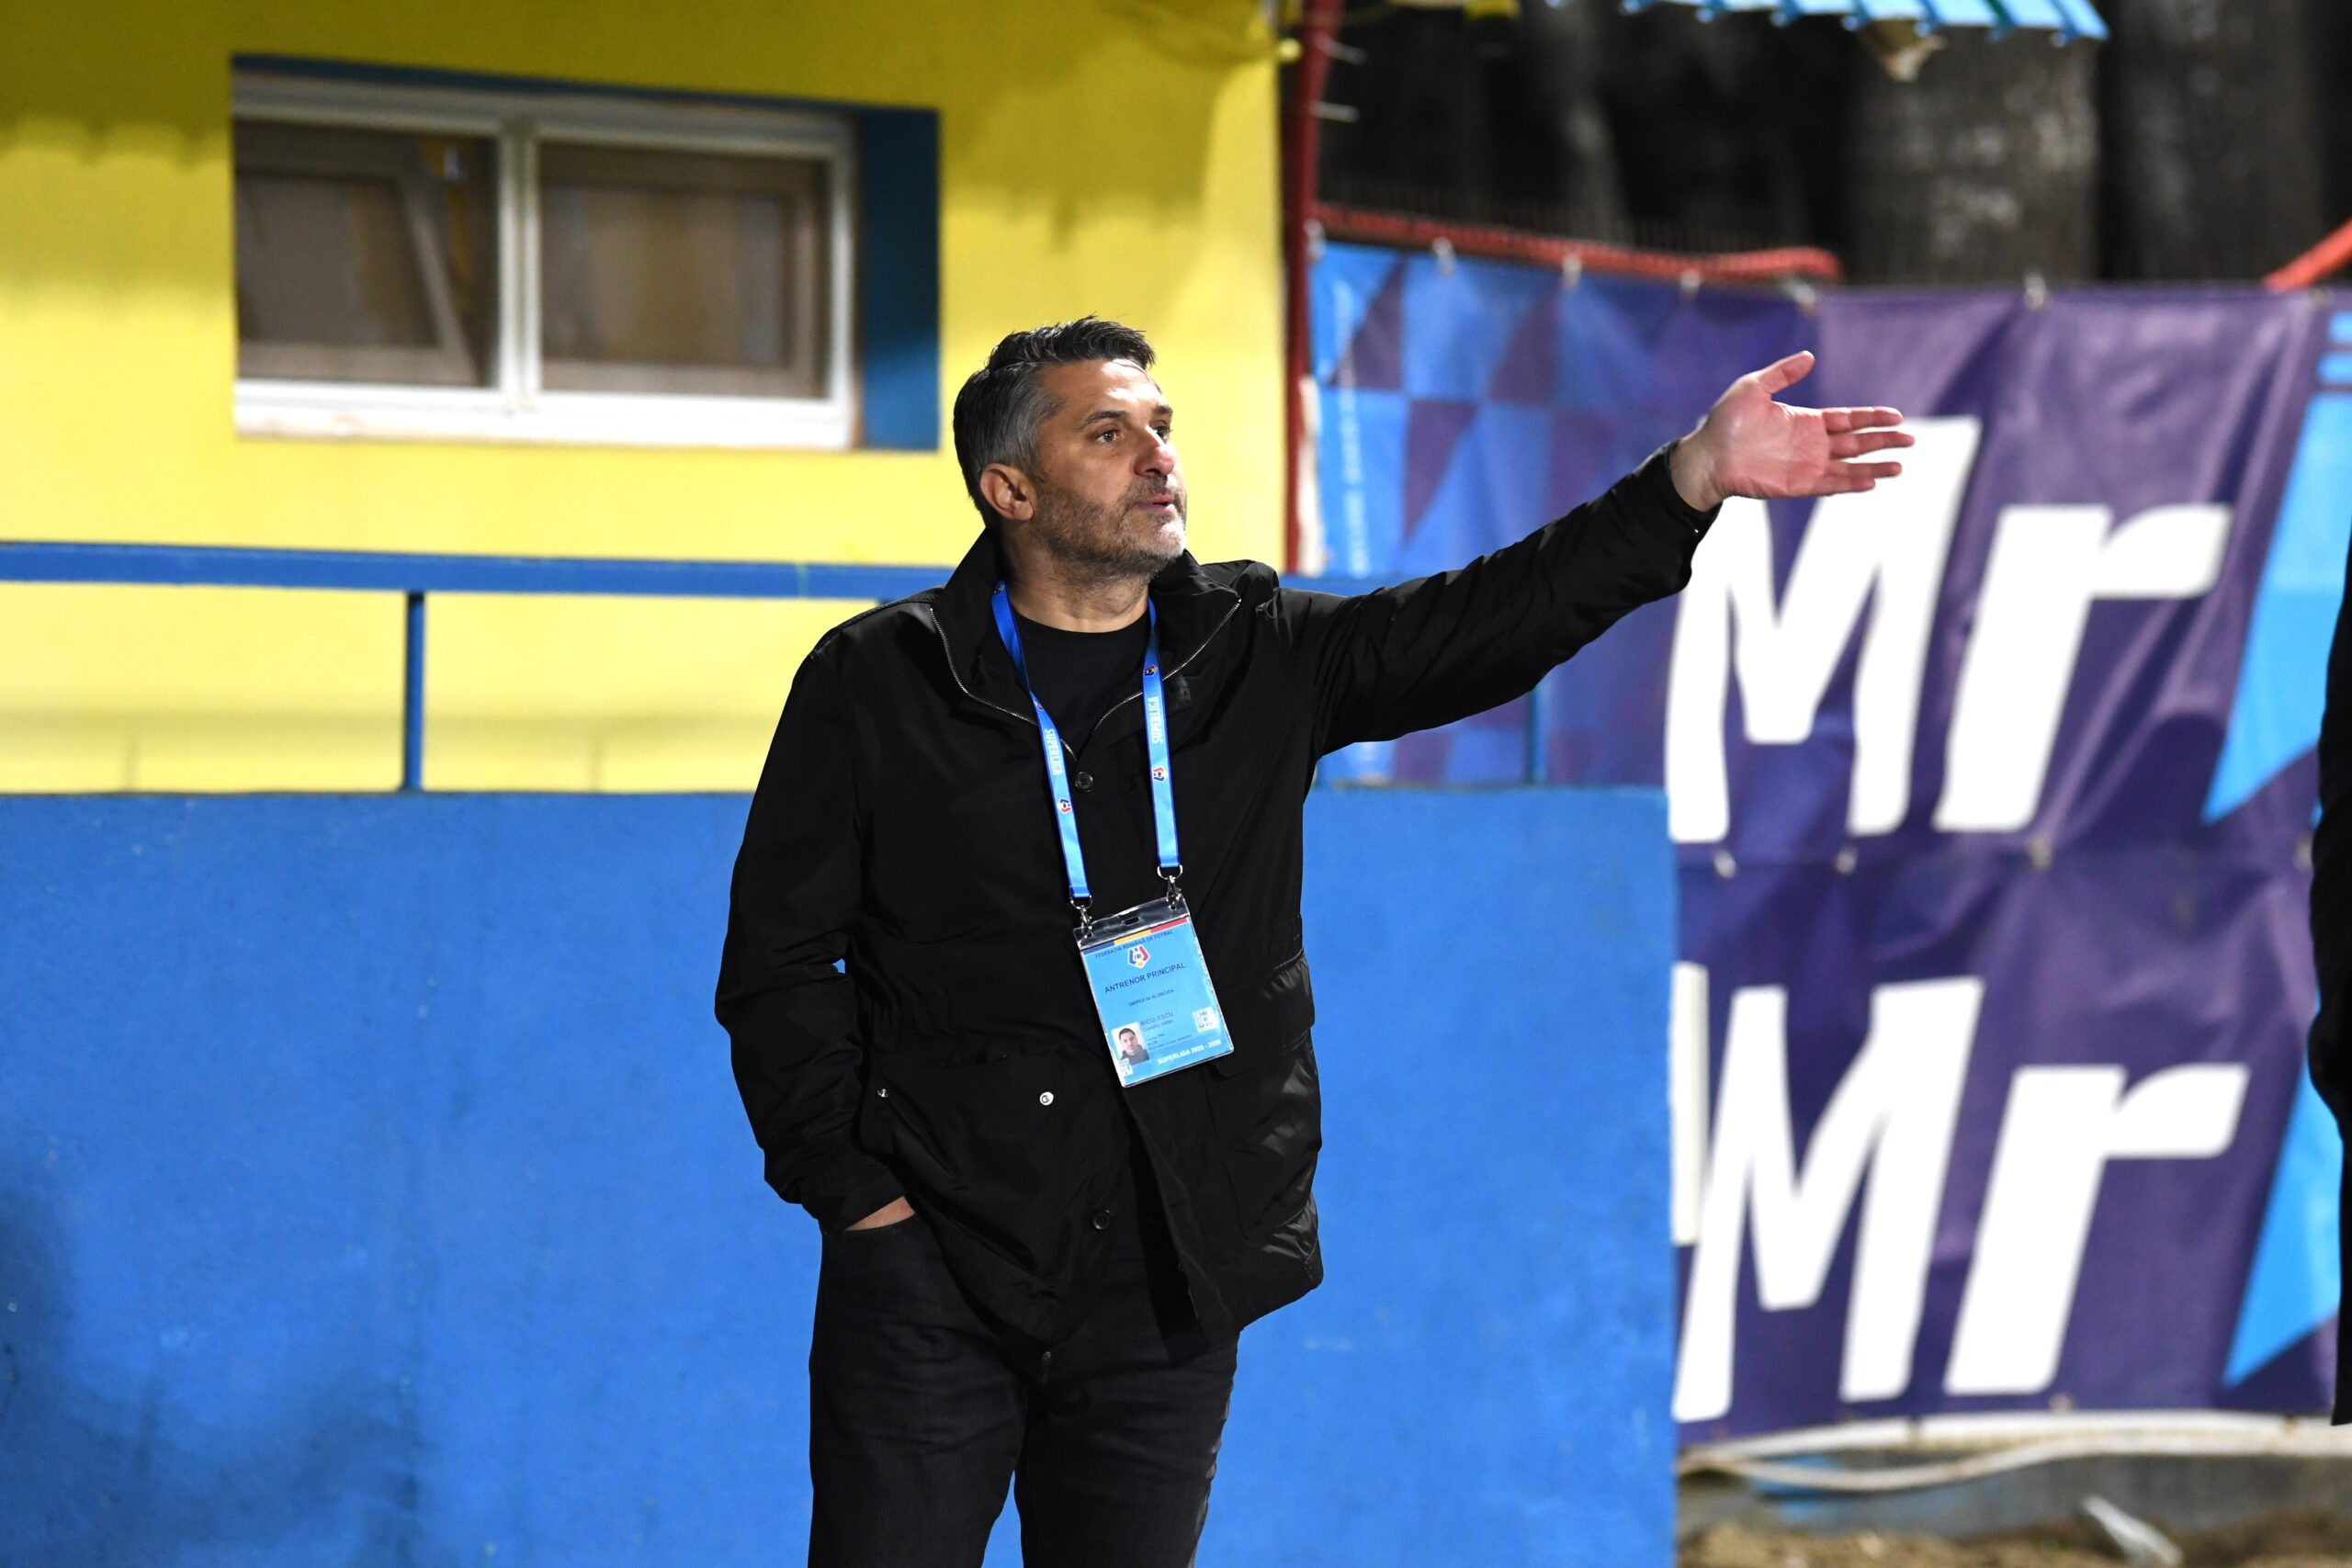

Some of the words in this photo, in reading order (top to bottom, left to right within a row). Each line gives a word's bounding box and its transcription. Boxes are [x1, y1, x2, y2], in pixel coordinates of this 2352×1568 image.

[1664, 416, 2234, 843] Mr
[1148, 696, 1163, 744] SUPERLIGA
[1045, 728, 1062, 775] SUPERLIGA
[1154, 930, 1173, 939] FOTBAL
[1104, 975, 1146, 993] ANTRENOR
[1147, 962, 1185, 979] PRINCIPAL
[1140, 1011, 1173, 1026] NICULESCU
[1158, 1050, 1191, 1064] SUPERLIGA
[1671, 976, 2250, 1422] Mr
